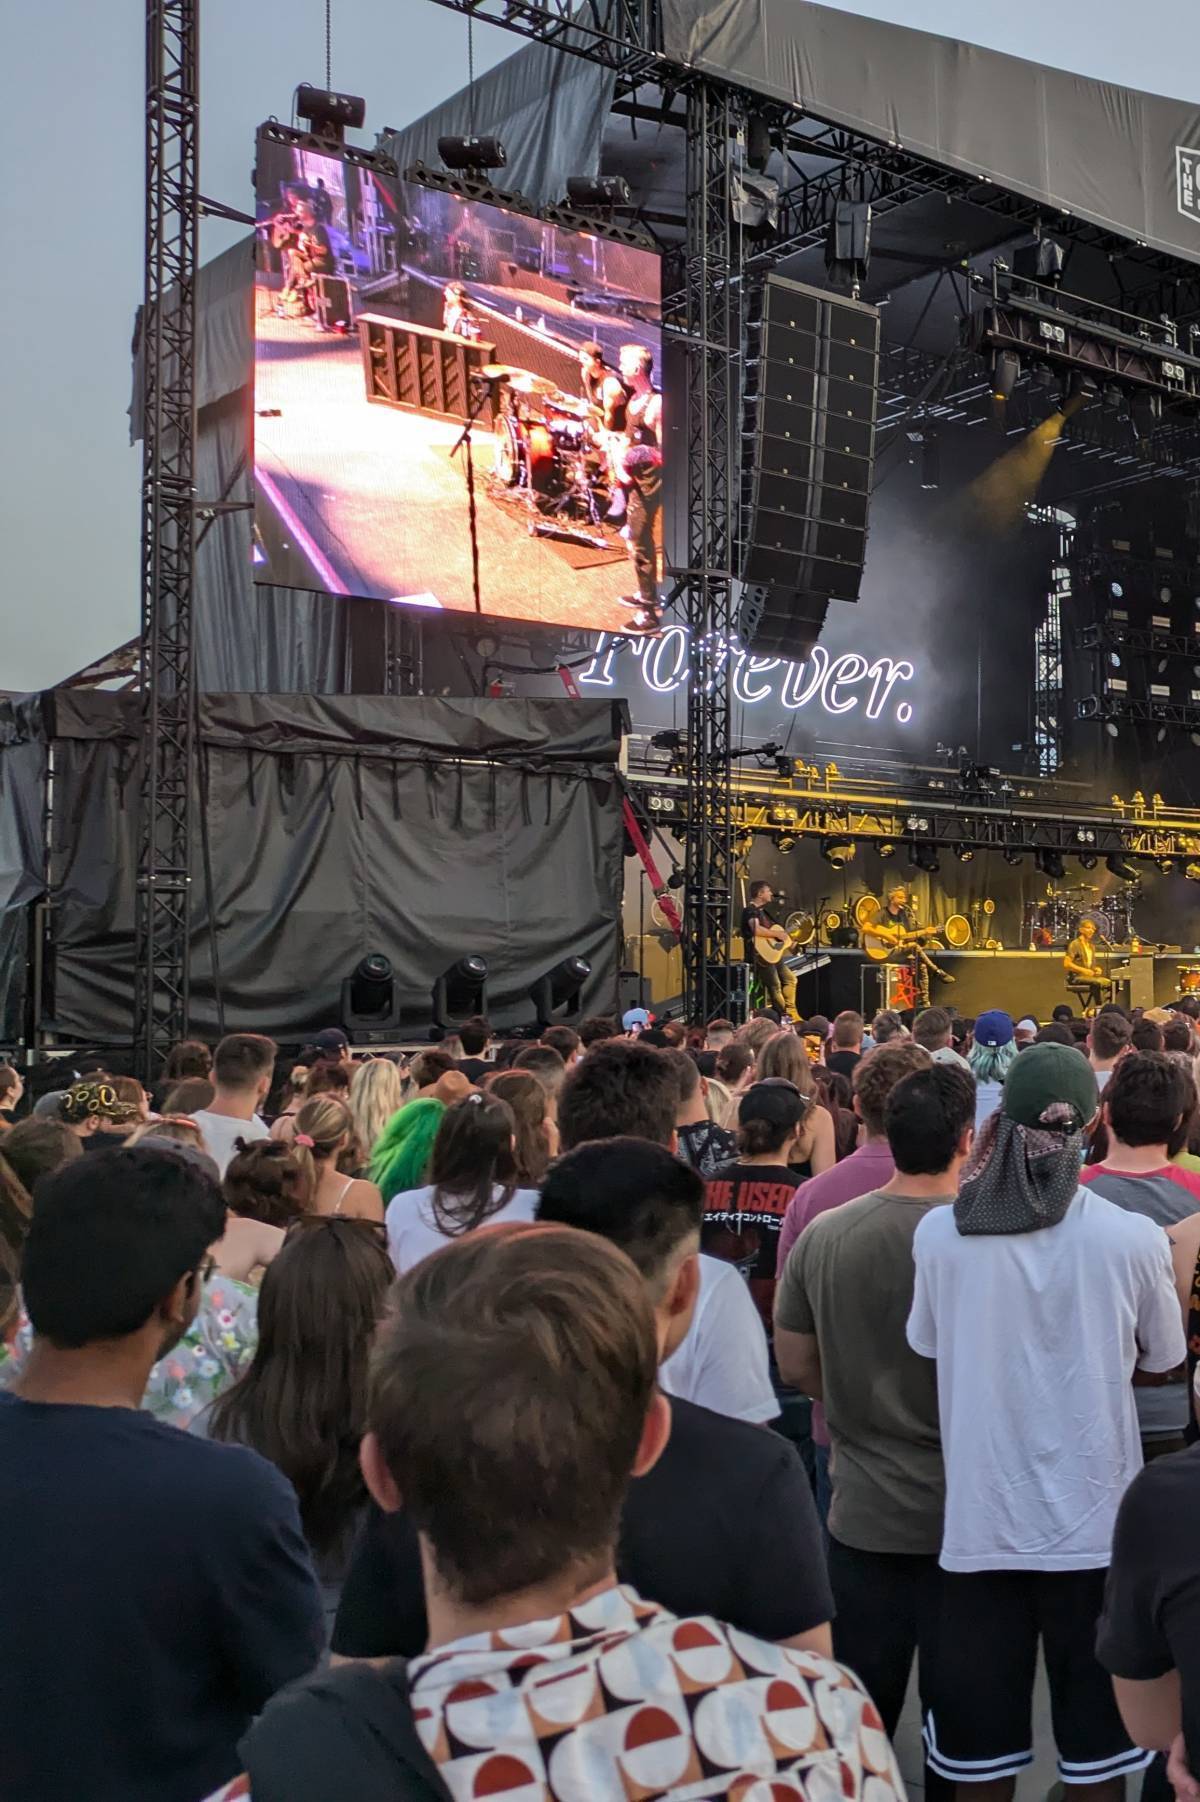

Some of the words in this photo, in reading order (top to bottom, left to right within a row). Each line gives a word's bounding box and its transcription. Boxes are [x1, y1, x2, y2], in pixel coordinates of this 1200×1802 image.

[1182, 157, 1194, 207] THE
[704, 1181, 735, 1211] HE
[736, 1181, 797, 1215] USED
